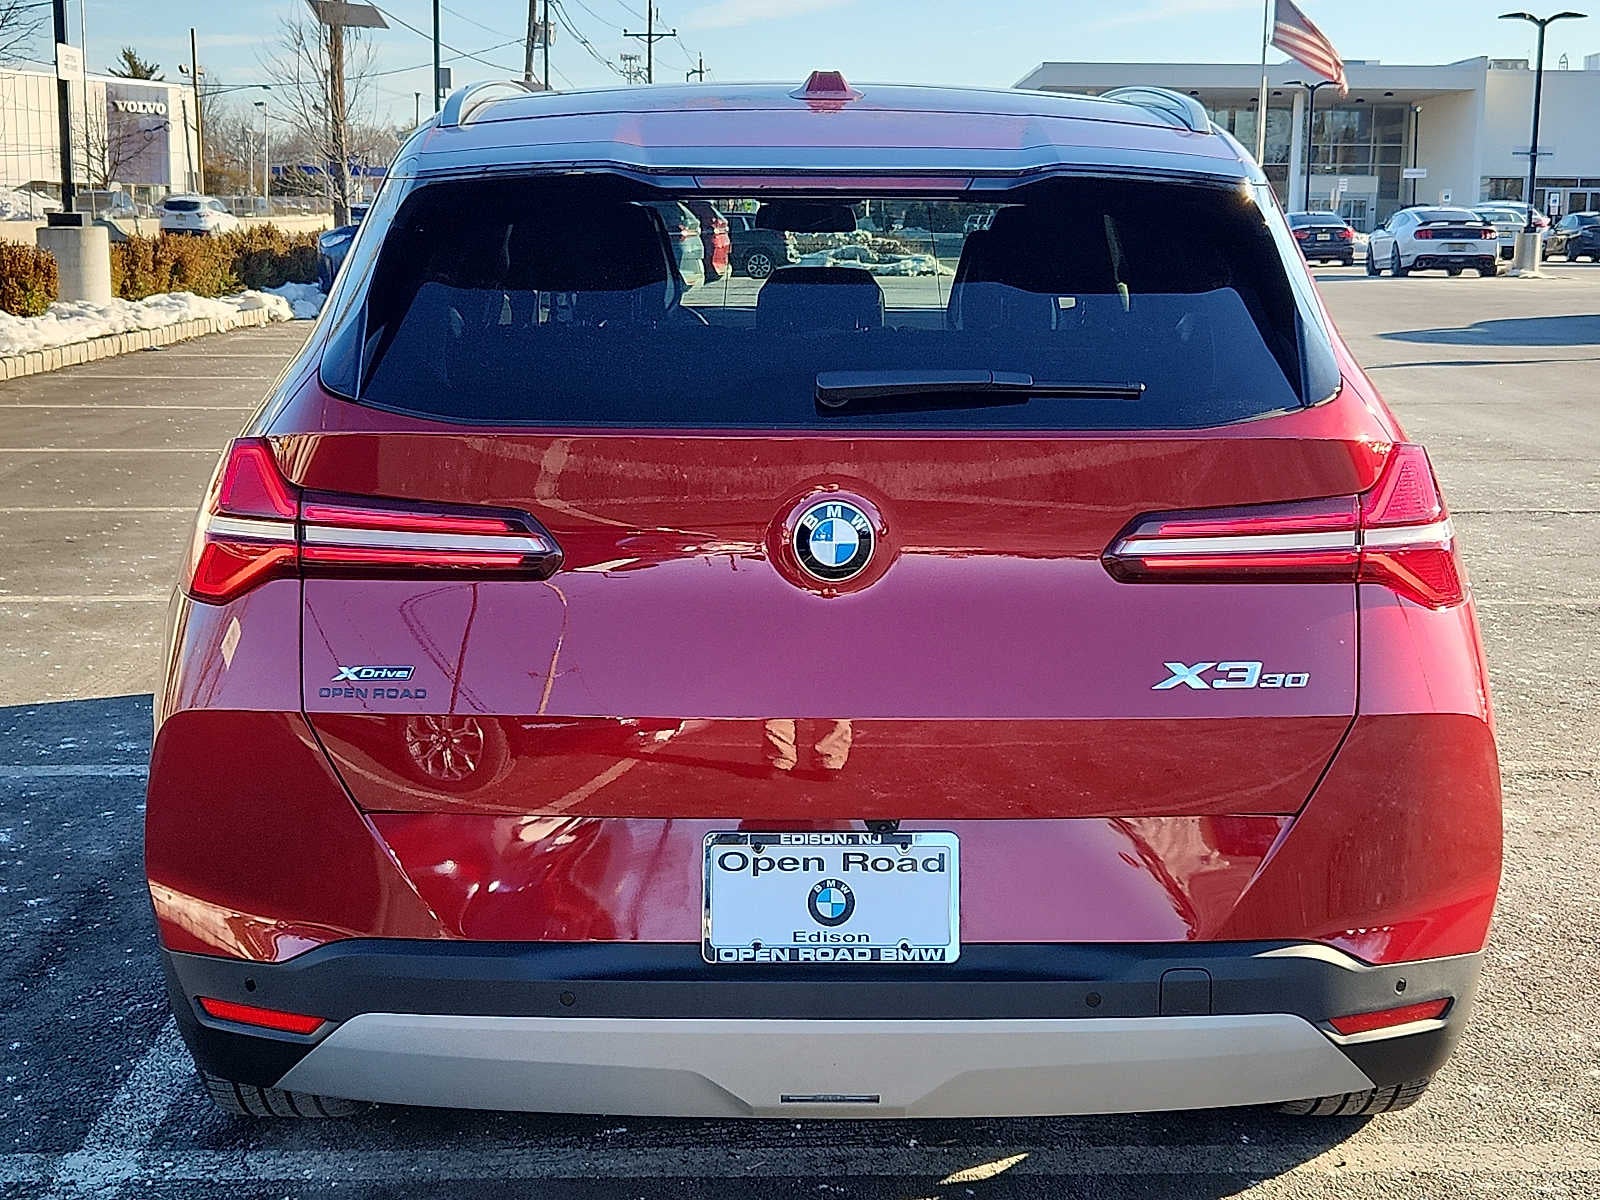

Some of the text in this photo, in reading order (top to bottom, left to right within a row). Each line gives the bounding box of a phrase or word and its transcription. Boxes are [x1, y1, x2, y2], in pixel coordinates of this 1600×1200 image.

[115, 100, 167, 115] VOLVO
[802, 505, 868, 531] BMW
[319, 687, 427, 699] OPEN ROAD
[780, 833, 883, 846] EDISON, NJ
[717, 851, 946, 877] Open Road
[814, 879, 851, 895] BMW
[792, 931, 870, 943] Edison
[719, 948, 943, 962] OPEN ROAD BMW
